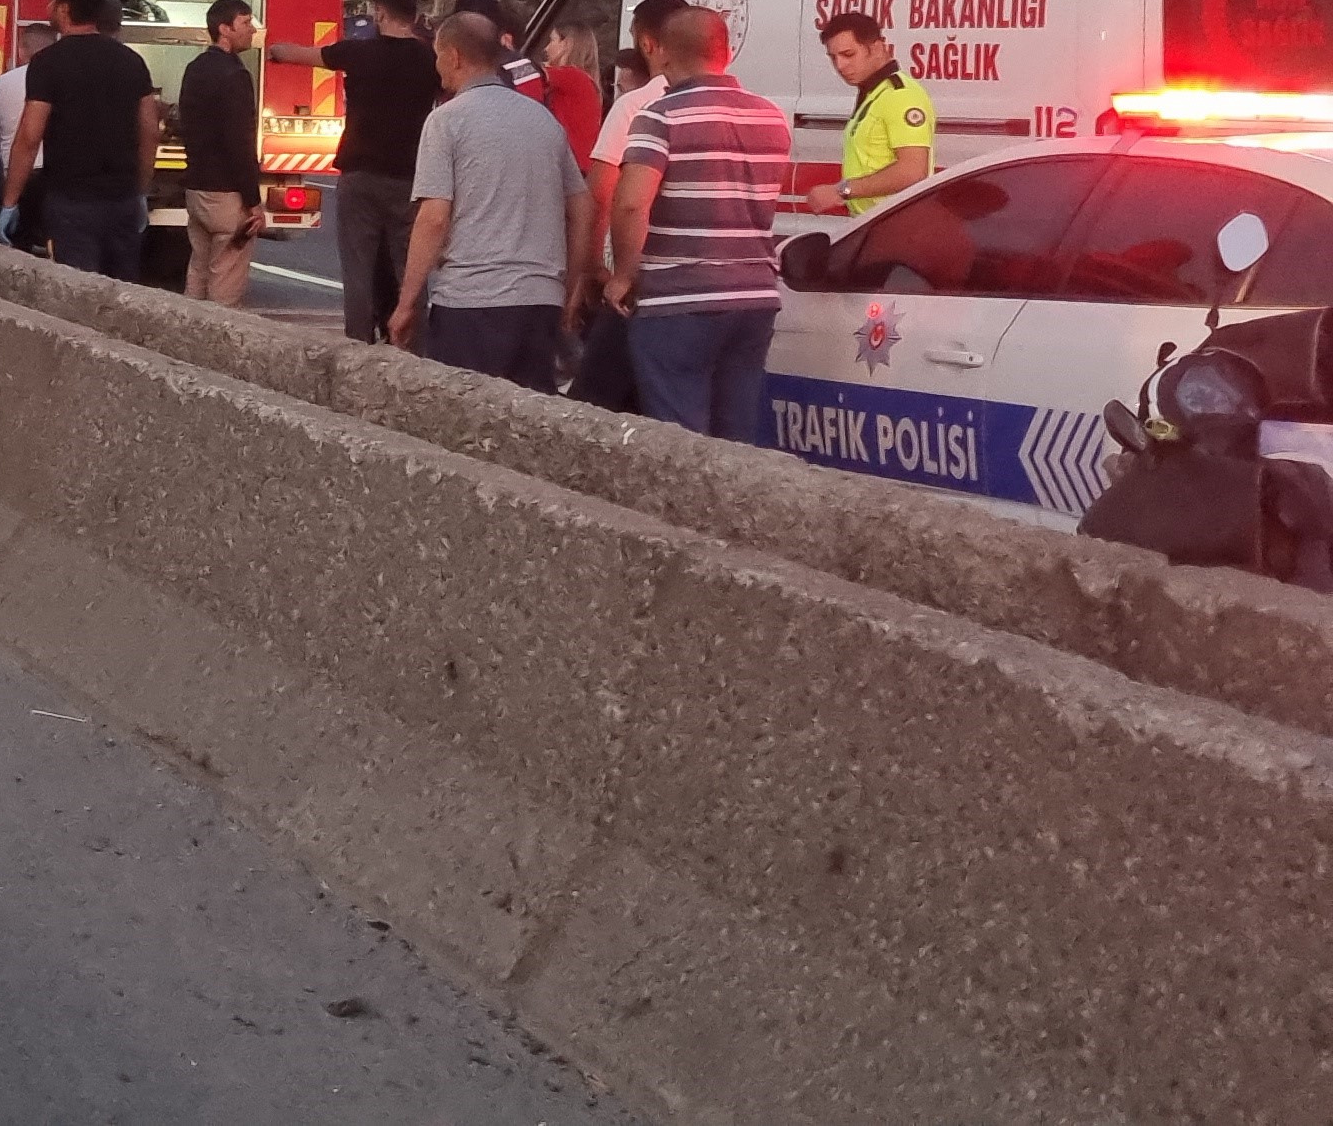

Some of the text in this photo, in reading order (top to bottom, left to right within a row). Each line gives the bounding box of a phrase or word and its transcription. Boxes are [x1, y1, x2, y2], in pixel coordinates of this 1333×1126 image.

[910, 34, 1001, 81] SAĞLIK
[1034, 106, 1078, 139] 112
[771, 392, 979, 482] TRAFİK POLİSİ
